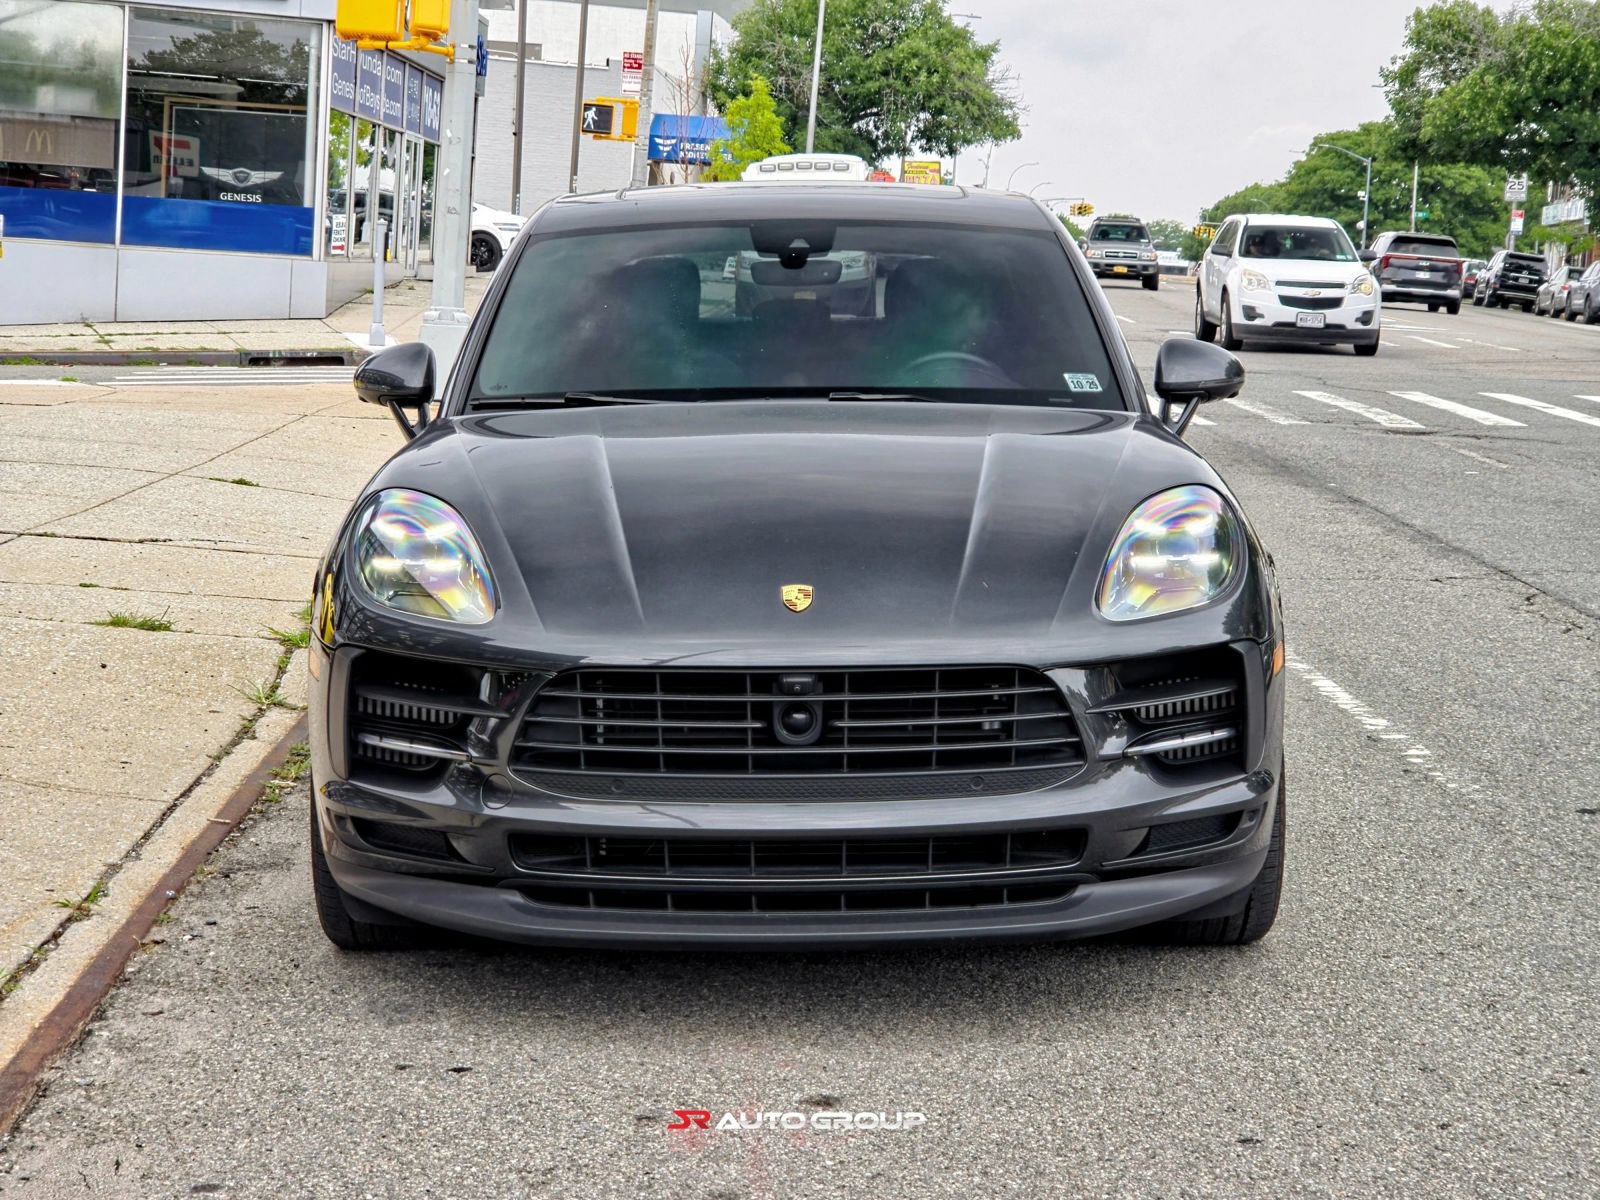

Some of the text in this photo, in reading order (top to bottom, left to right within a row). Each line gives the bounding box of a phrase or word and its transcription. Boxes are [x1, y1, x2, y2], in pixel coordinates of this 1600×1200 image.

[1508, 180, 1525, 191] 25
[219, 191, 262, 203] GENESIS
[1070, 380, 1084, 390] 10
